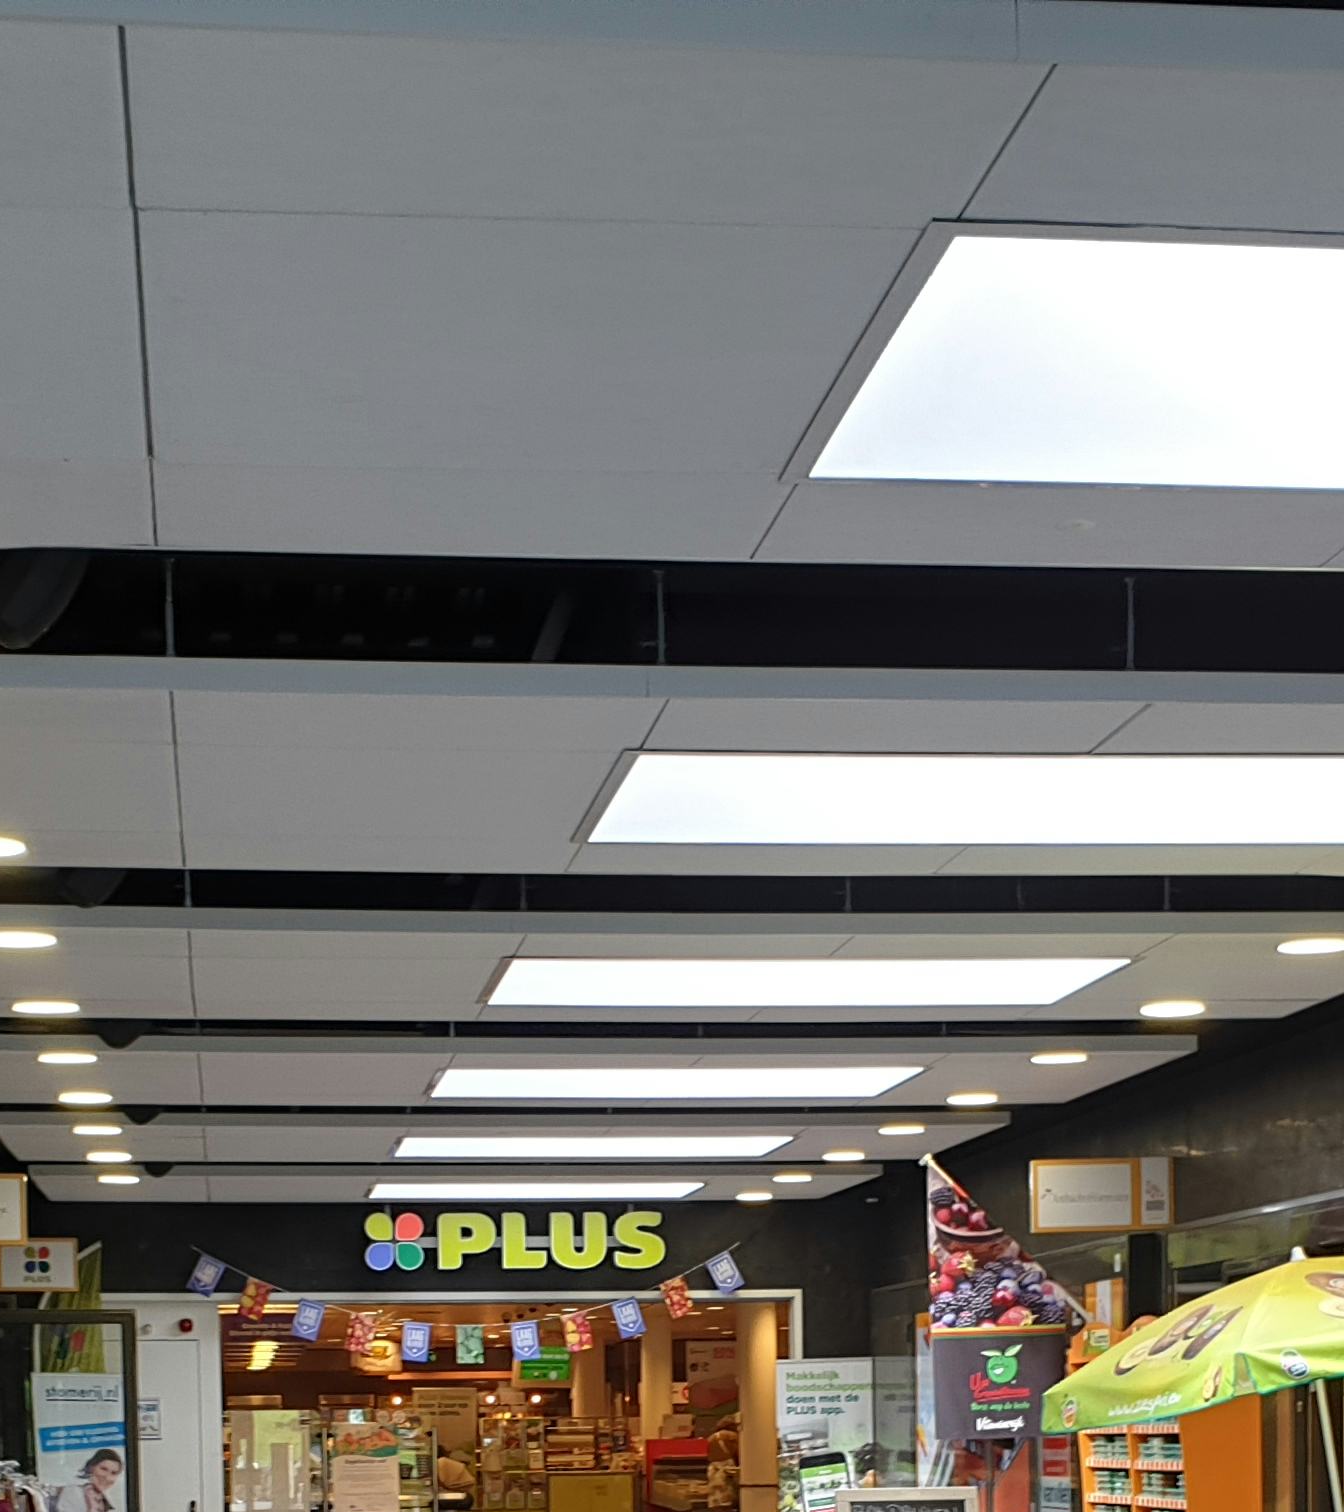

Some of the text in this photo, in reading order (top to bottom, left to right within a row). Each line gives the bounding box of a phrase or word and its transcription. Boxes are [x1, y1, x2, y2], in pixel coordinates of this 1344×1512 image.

[437, 1211, 666, 1270] PLUS
[786, 1393, 860, 1403] doen met de
[786, 1406, 817, 1415] PLUS
